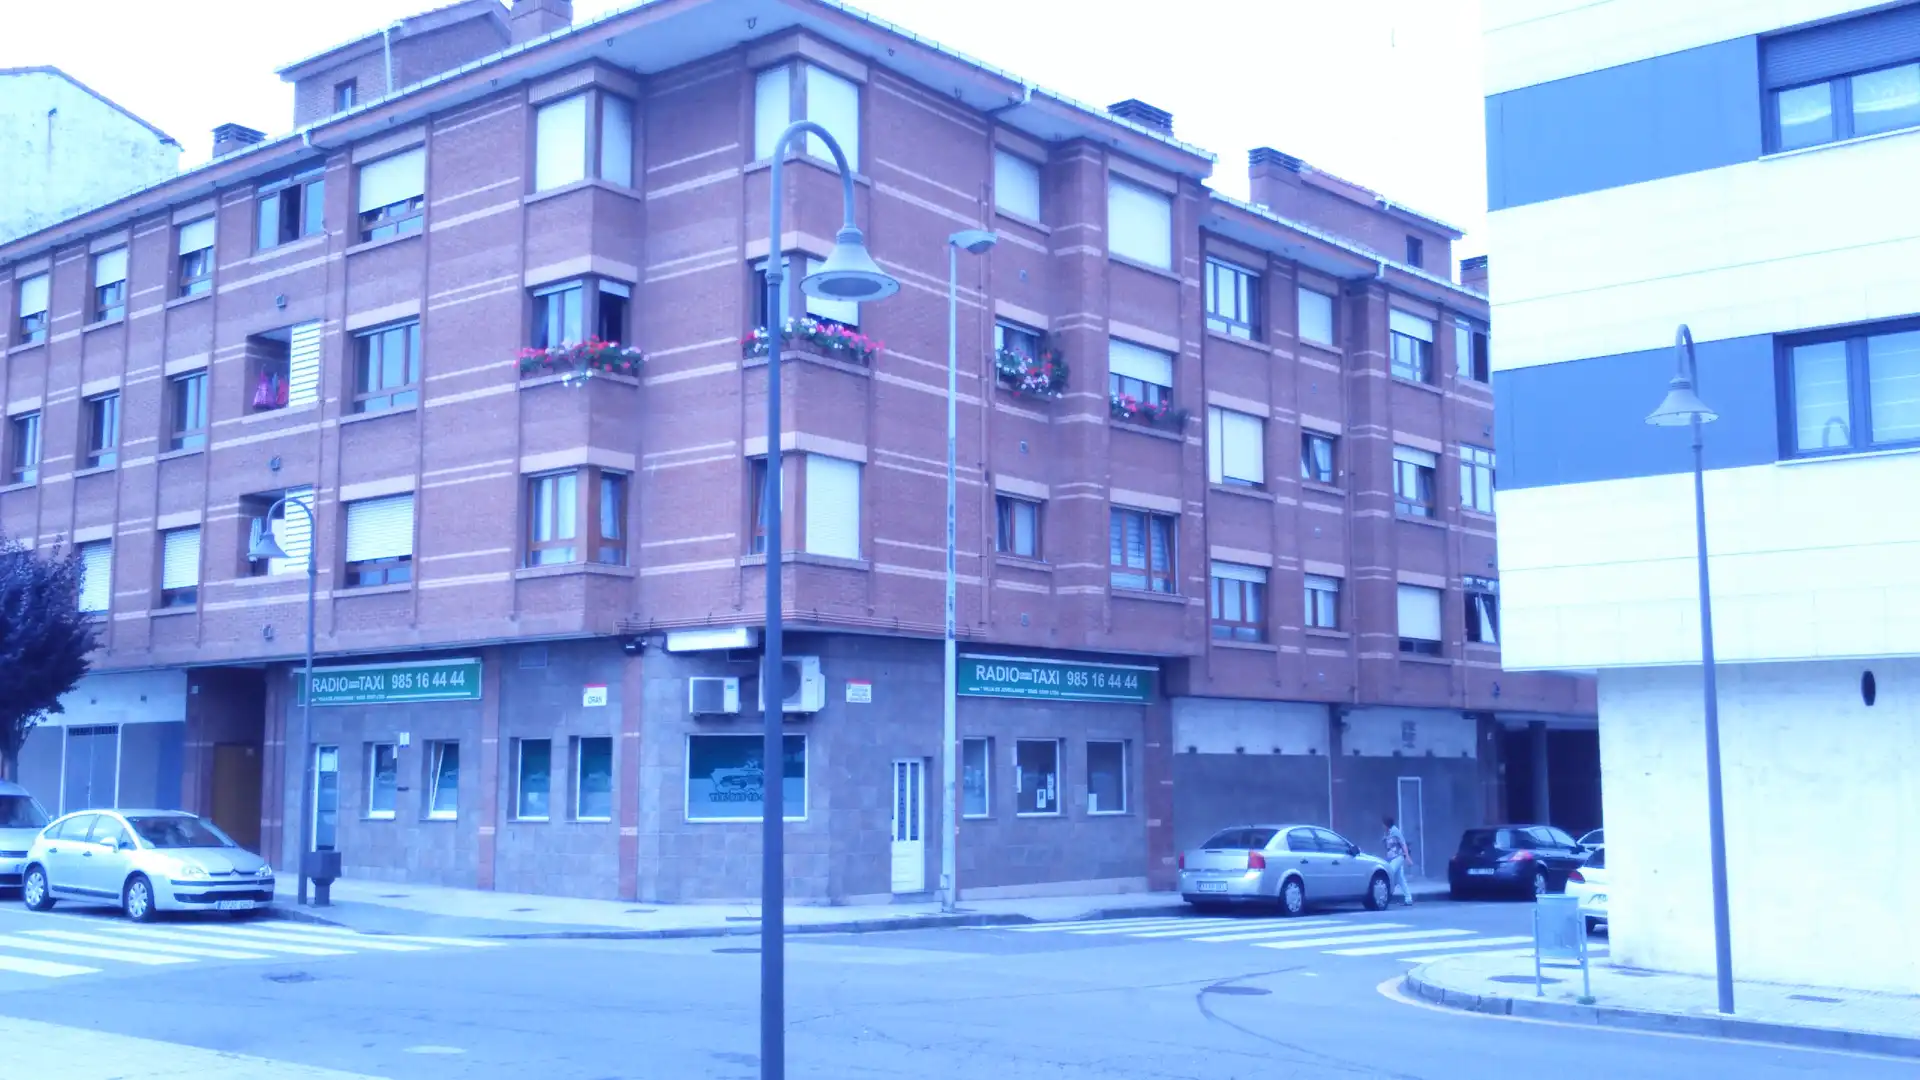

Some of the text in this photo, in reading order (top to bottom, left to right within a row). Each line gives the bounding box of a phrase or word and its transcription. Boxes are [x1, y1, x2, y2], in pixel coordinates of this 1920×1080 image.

[391, 673, 413, 689] 985
[416, 672, 430, 688] 16
[432, 671, 447, 687] 44
[449, 670, 465, 686] 44
[1066, 670, 1088, 687] 985
[1092, 672, 1105, 688] 16
[1107, 673, 1121, 688] 44
[1124, 674, 1138, 689] 44
